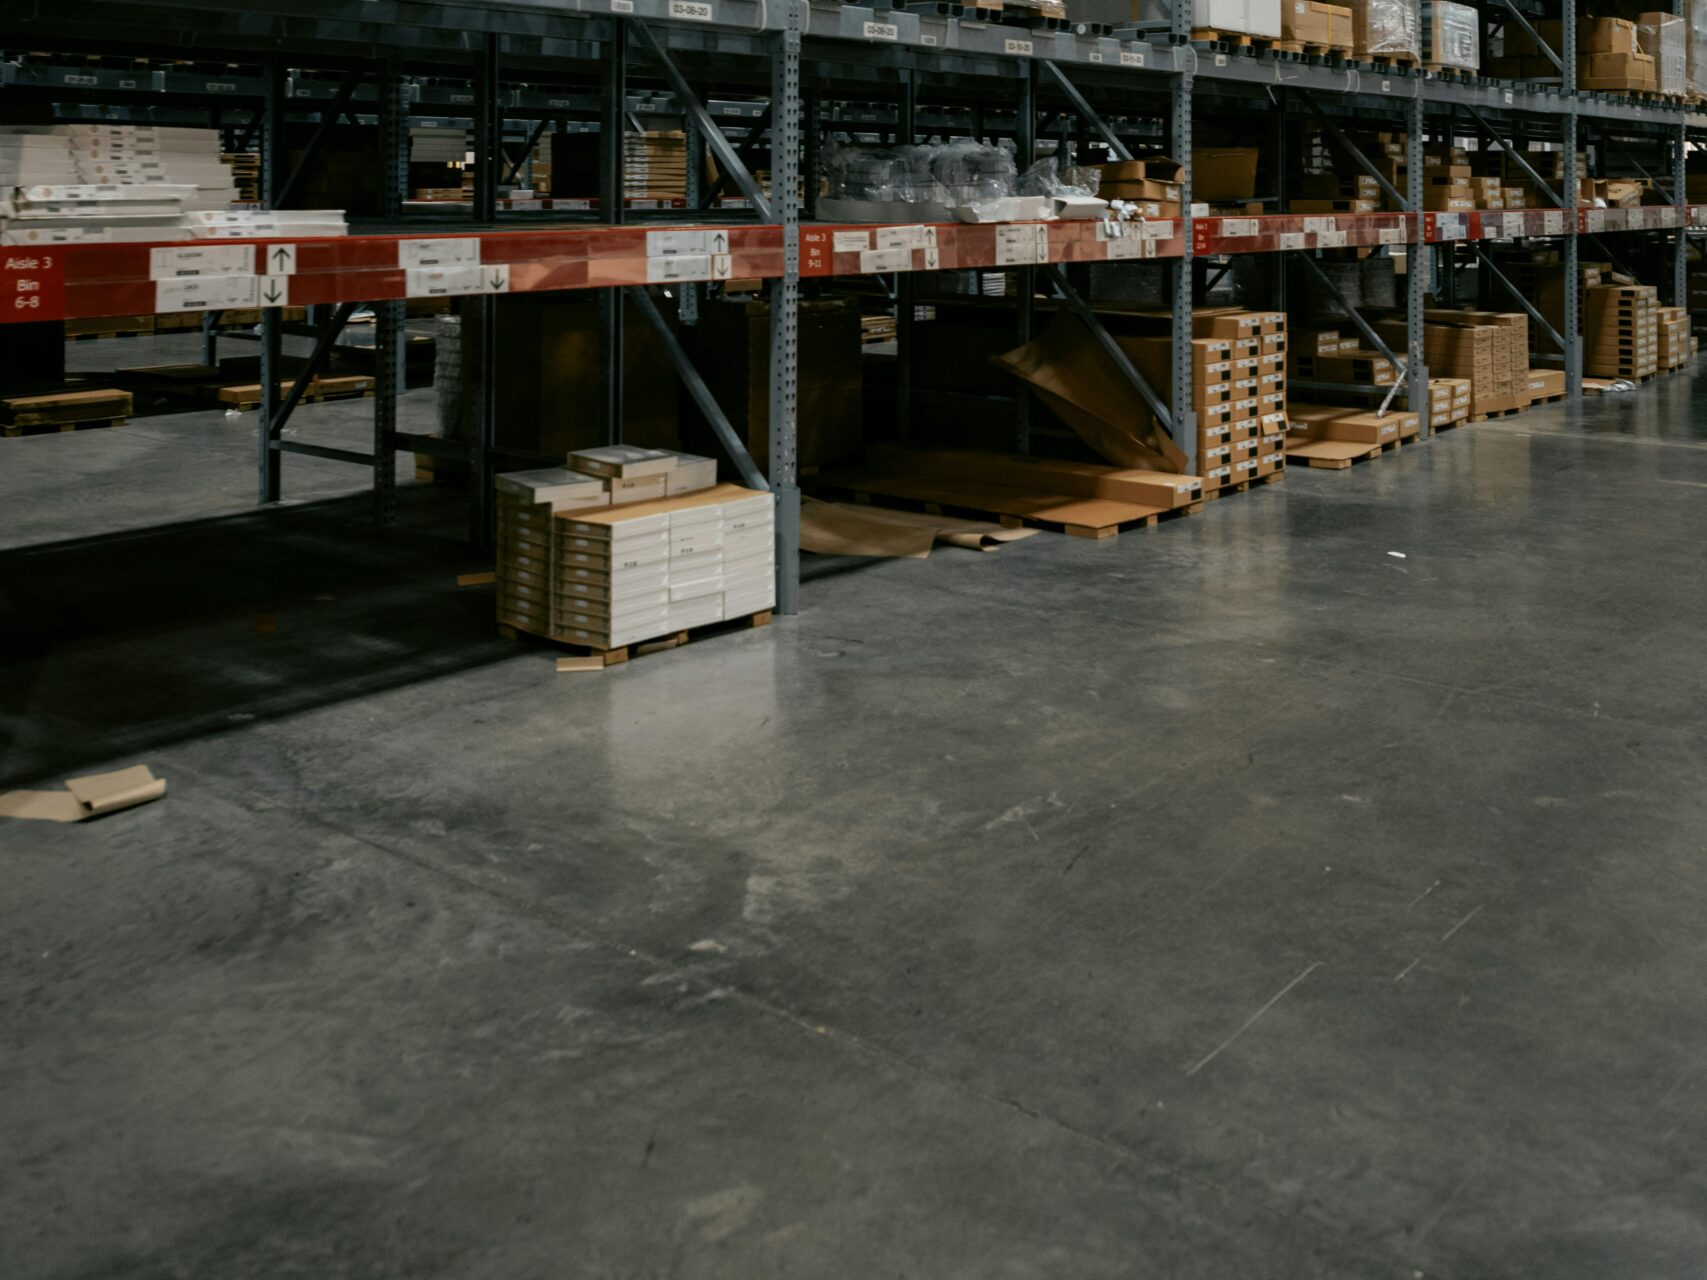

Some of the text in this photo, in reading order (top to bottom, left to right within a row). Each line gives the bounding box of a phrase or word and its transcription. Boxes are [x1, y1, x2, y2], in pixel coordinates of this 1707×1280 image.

[805, 233, 820, 242] Aisle
[810, 248, 821, 256] Bin
[5, 256, 52, 270] Aisle 3
[16, 279, 39, 292] Bin
[15, 296, 40, 308] 6-8
